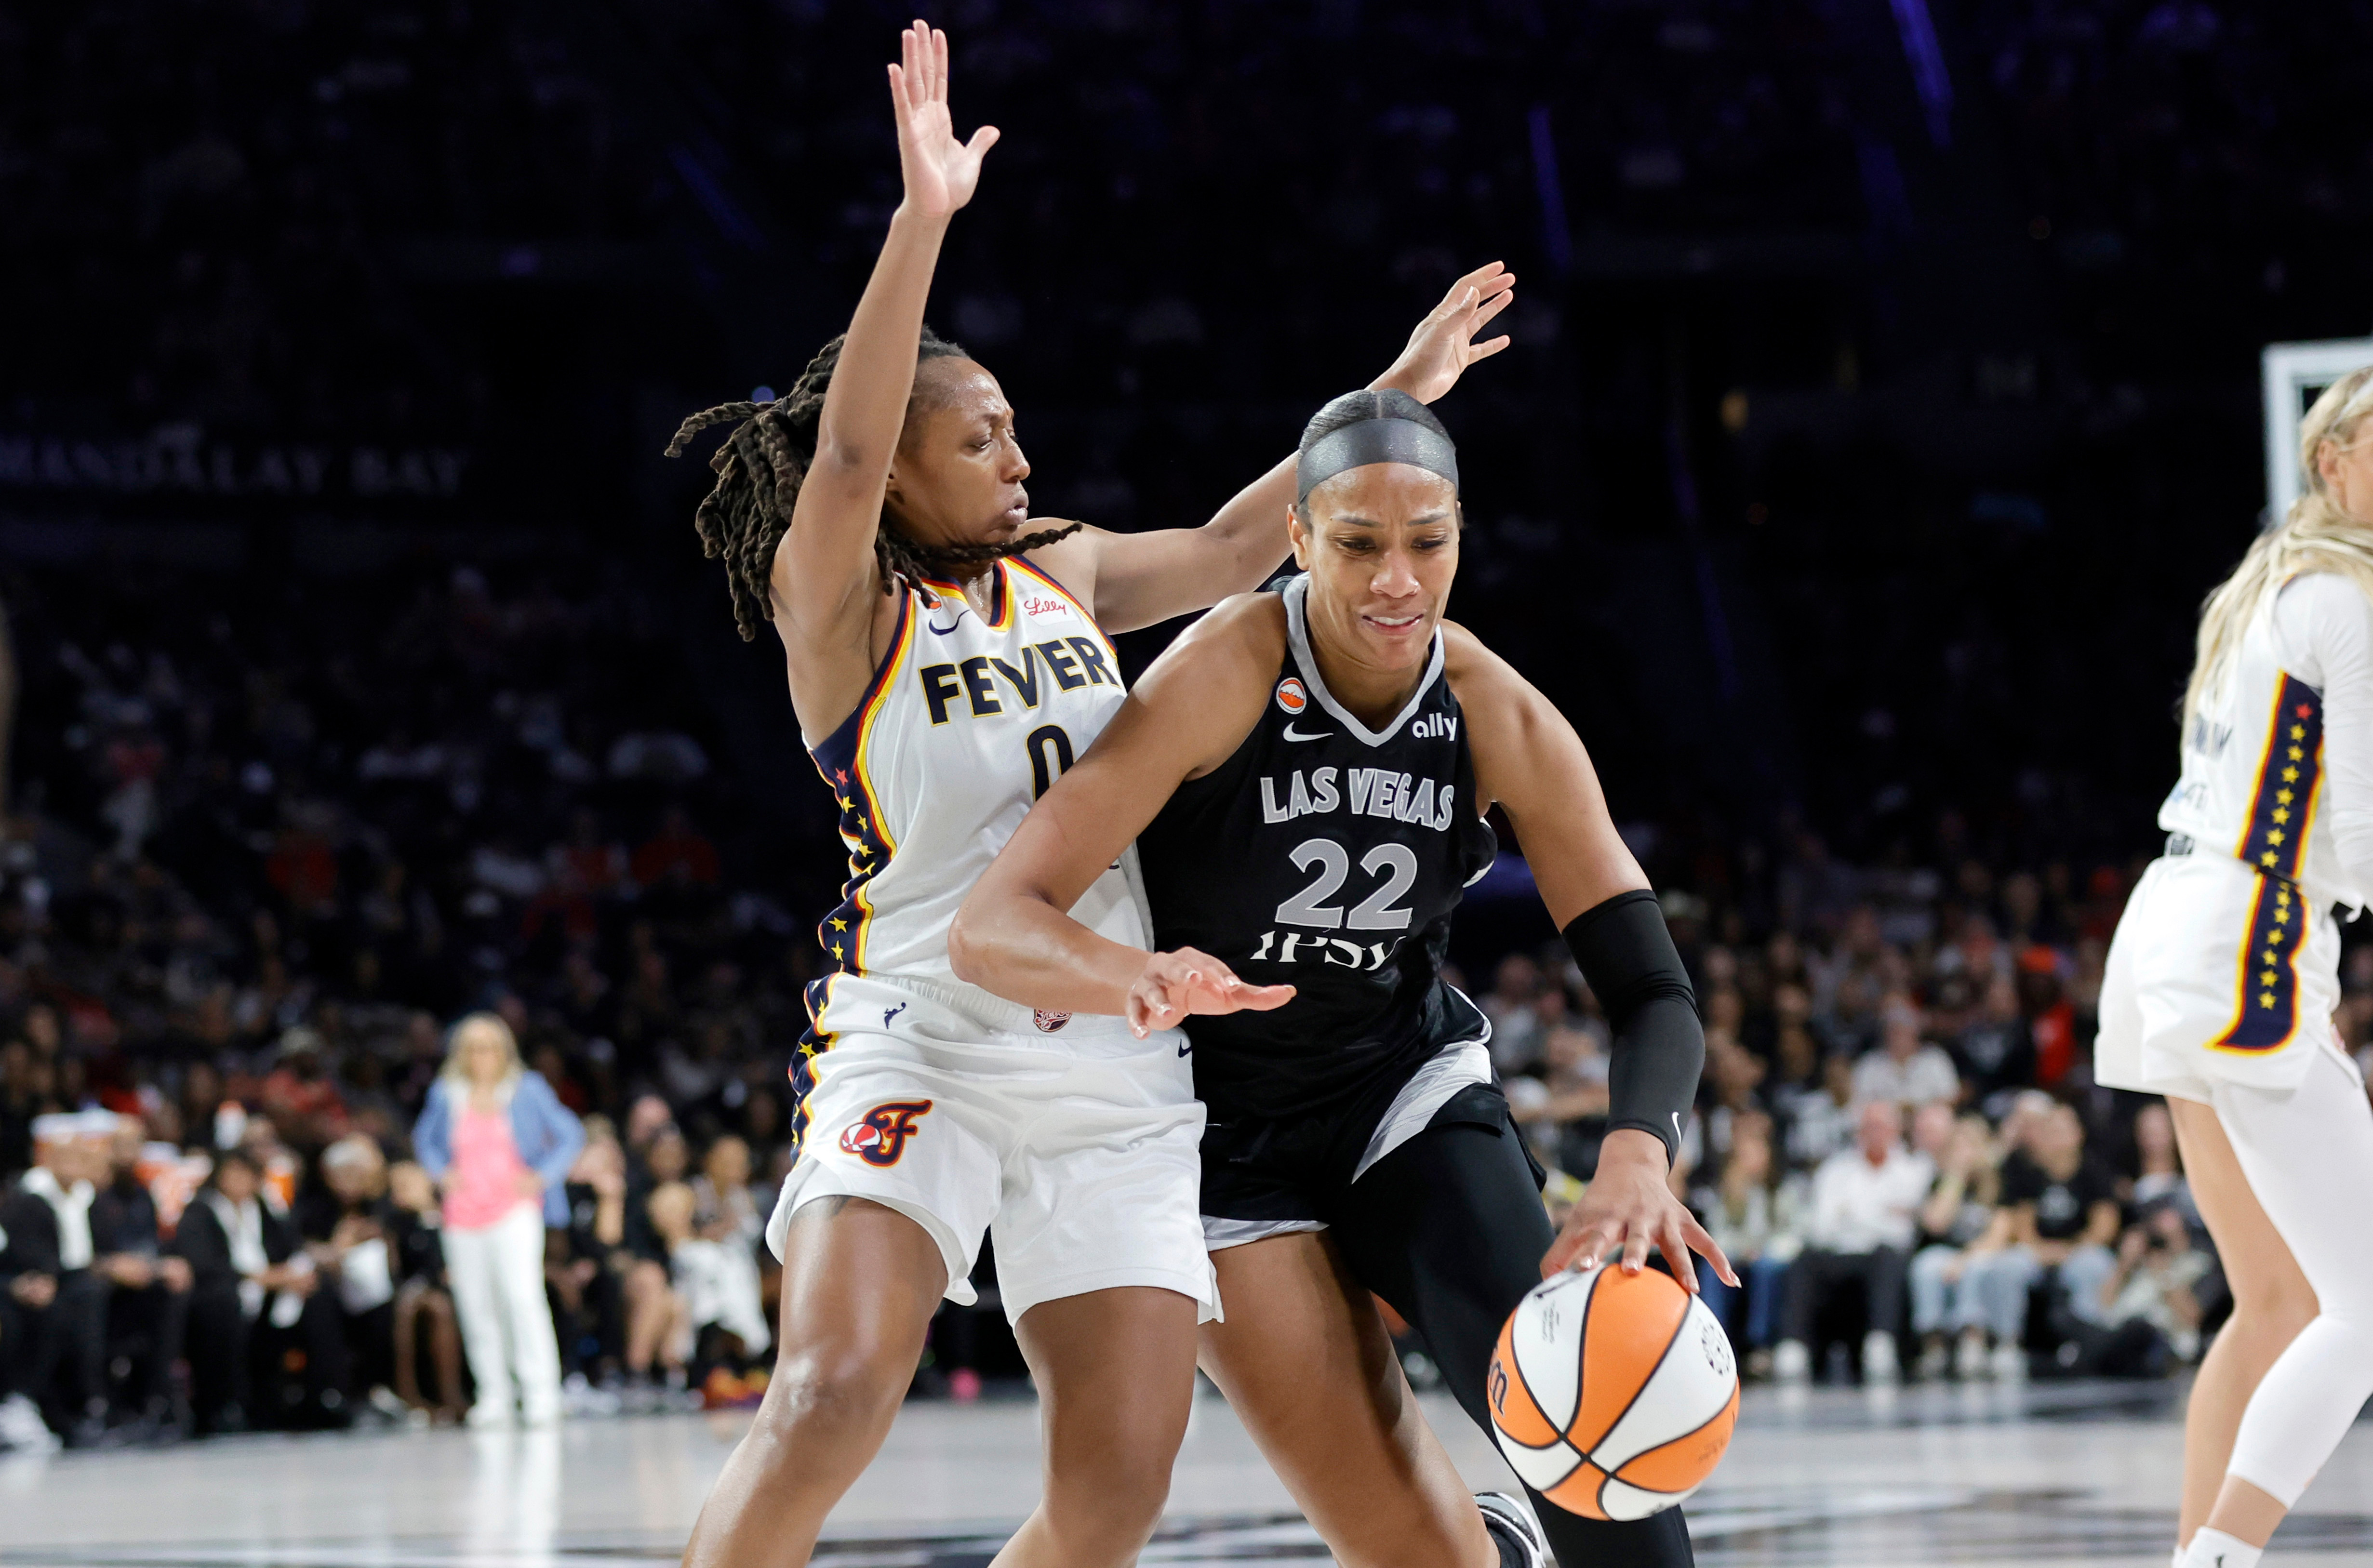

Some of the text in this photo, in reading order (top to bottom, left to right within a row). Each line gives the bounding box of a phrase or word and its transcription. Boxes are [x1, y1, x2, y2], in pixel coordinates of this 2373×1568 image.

[352, 441, 472, 498] BAY
[1024, 597, 1067, 617] Lilly
[918, 636, 1121, 727] FEVER
[1412, 712, 1457, 741] ally
[1260, 766, 1454, 831] LAS VEGAS
[1274, 838, 1418, 930] 22
